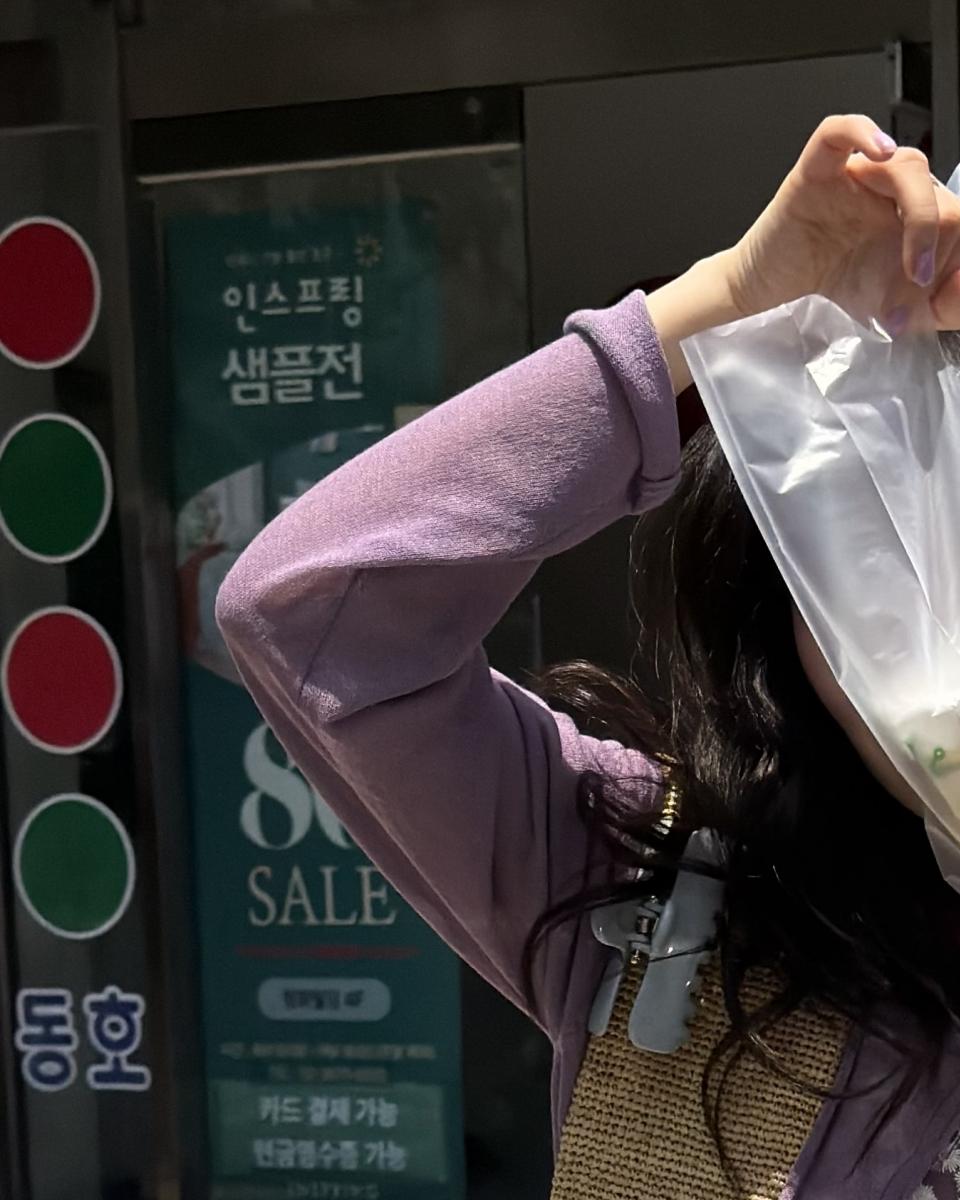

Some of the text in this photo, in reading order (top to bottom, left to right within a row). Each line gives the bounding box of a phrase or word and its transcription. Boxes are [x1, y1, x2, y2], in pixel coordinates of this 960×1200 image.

[222, 275, 364, 334] 인스프링
[220, 341, 364, 406] 샘플전
[247, 863, 398, 927] SALE
[14, 984, 152, 1092] 동호
[258, 1095, 399, 1128] 카드 결제 가능
[364, 1140, 408, 1172] 가능
